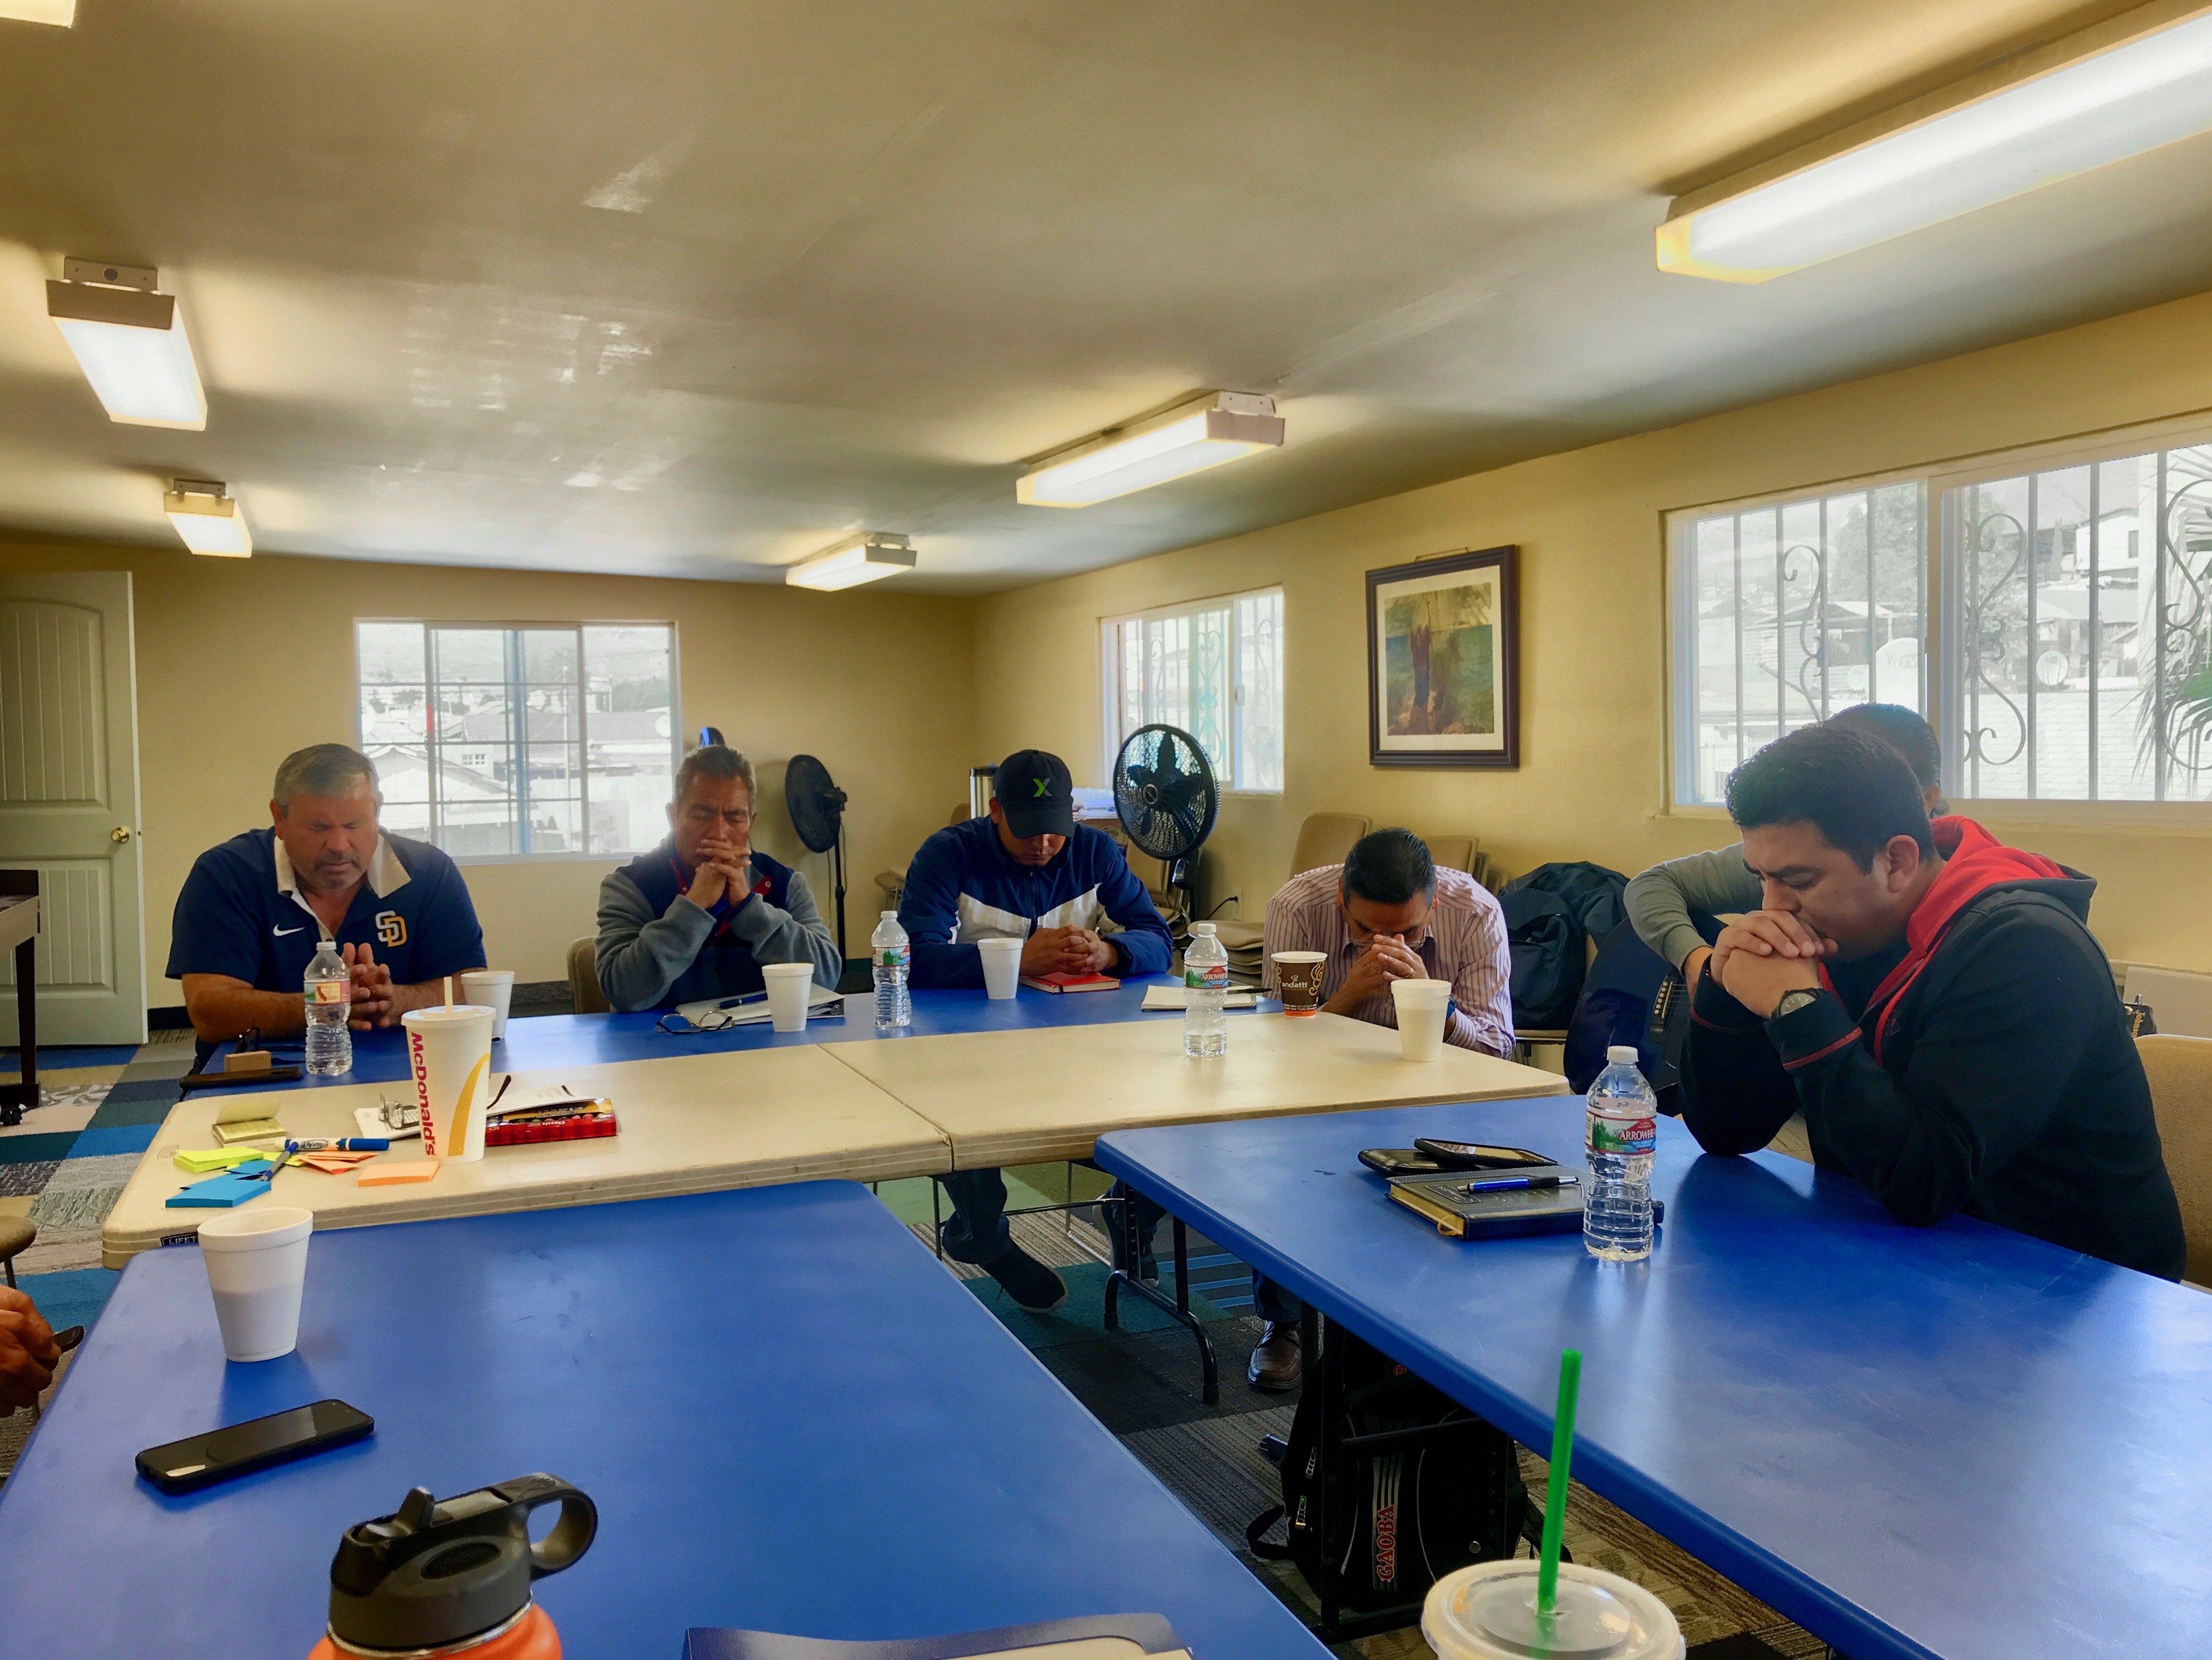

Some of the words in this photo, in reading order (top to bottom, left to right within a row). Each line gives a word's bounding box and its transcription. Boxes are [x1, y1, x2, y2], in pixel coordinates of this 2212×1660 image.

[376, 910, 408, 948] SD
[411, 1032, 436, 1157] McDonald's
[1376, 1504, 1395, 1581] GAOBA
